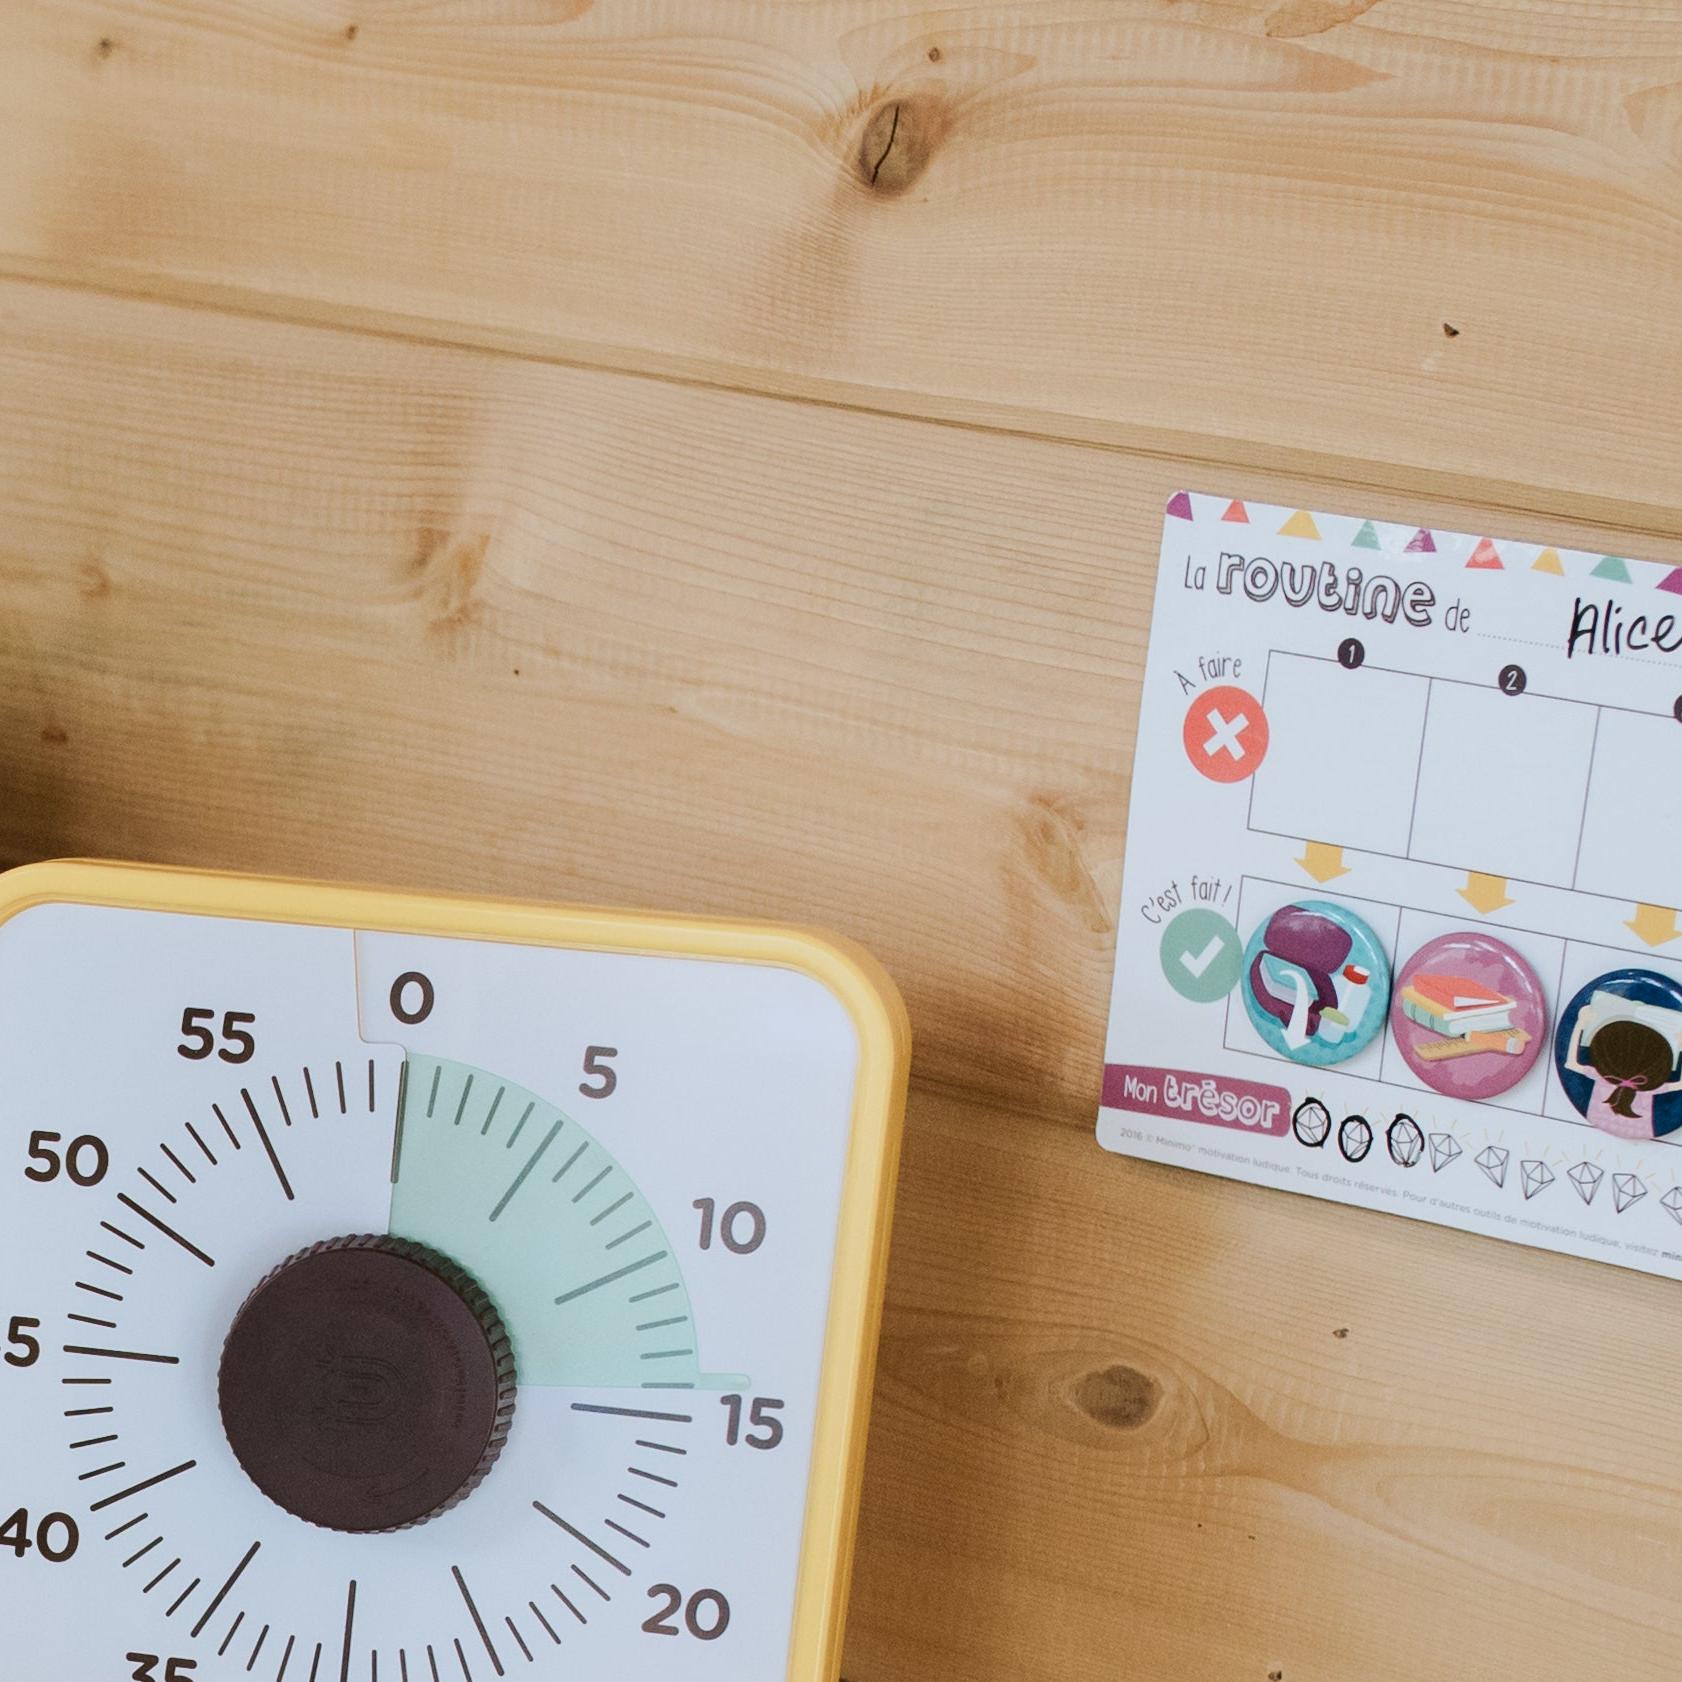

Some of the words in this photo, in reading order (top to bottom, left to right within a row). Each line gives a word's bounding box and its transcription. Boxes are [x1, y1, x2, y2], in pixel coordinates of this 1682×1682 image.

[1216, 551, 1436, 627] routine
[1444, 598, 1471, 633] de
[1567, 596, 1682, 659] Alice
[1198, 650, 1242, 682] faire
[389, 971, 435, 1025] 0
[177, 1007, 256, 1065] 55
[579, 1045, 618, 1099] 5
[1123, 1074, 1158, 1104] Mon
[1163, 1073, 1281, 1129] trésor
[24, 1130, 109, 1187] 50
[1120, 1127, 1143, 1141] 2016
[1198, 1146, 1251, 1165] motivation
[1296, 1166, 1319, 1181] Tous
[1322, 1173, 1353, 1188] droits
[1403, 1189, 1427, 1203] Pour
[1429, 1197, 1471, 1214] d'autres
[1473, 1207, 1501, 1222] outils
[1503, 1213, 1517, 1225] de
[1519, 1218, 1578, 1239] motivation
[693, 1197, 766, 1255] 10
[720, 1394, 785, 1450] 15
[641, 1583, 731, 1641] 20
